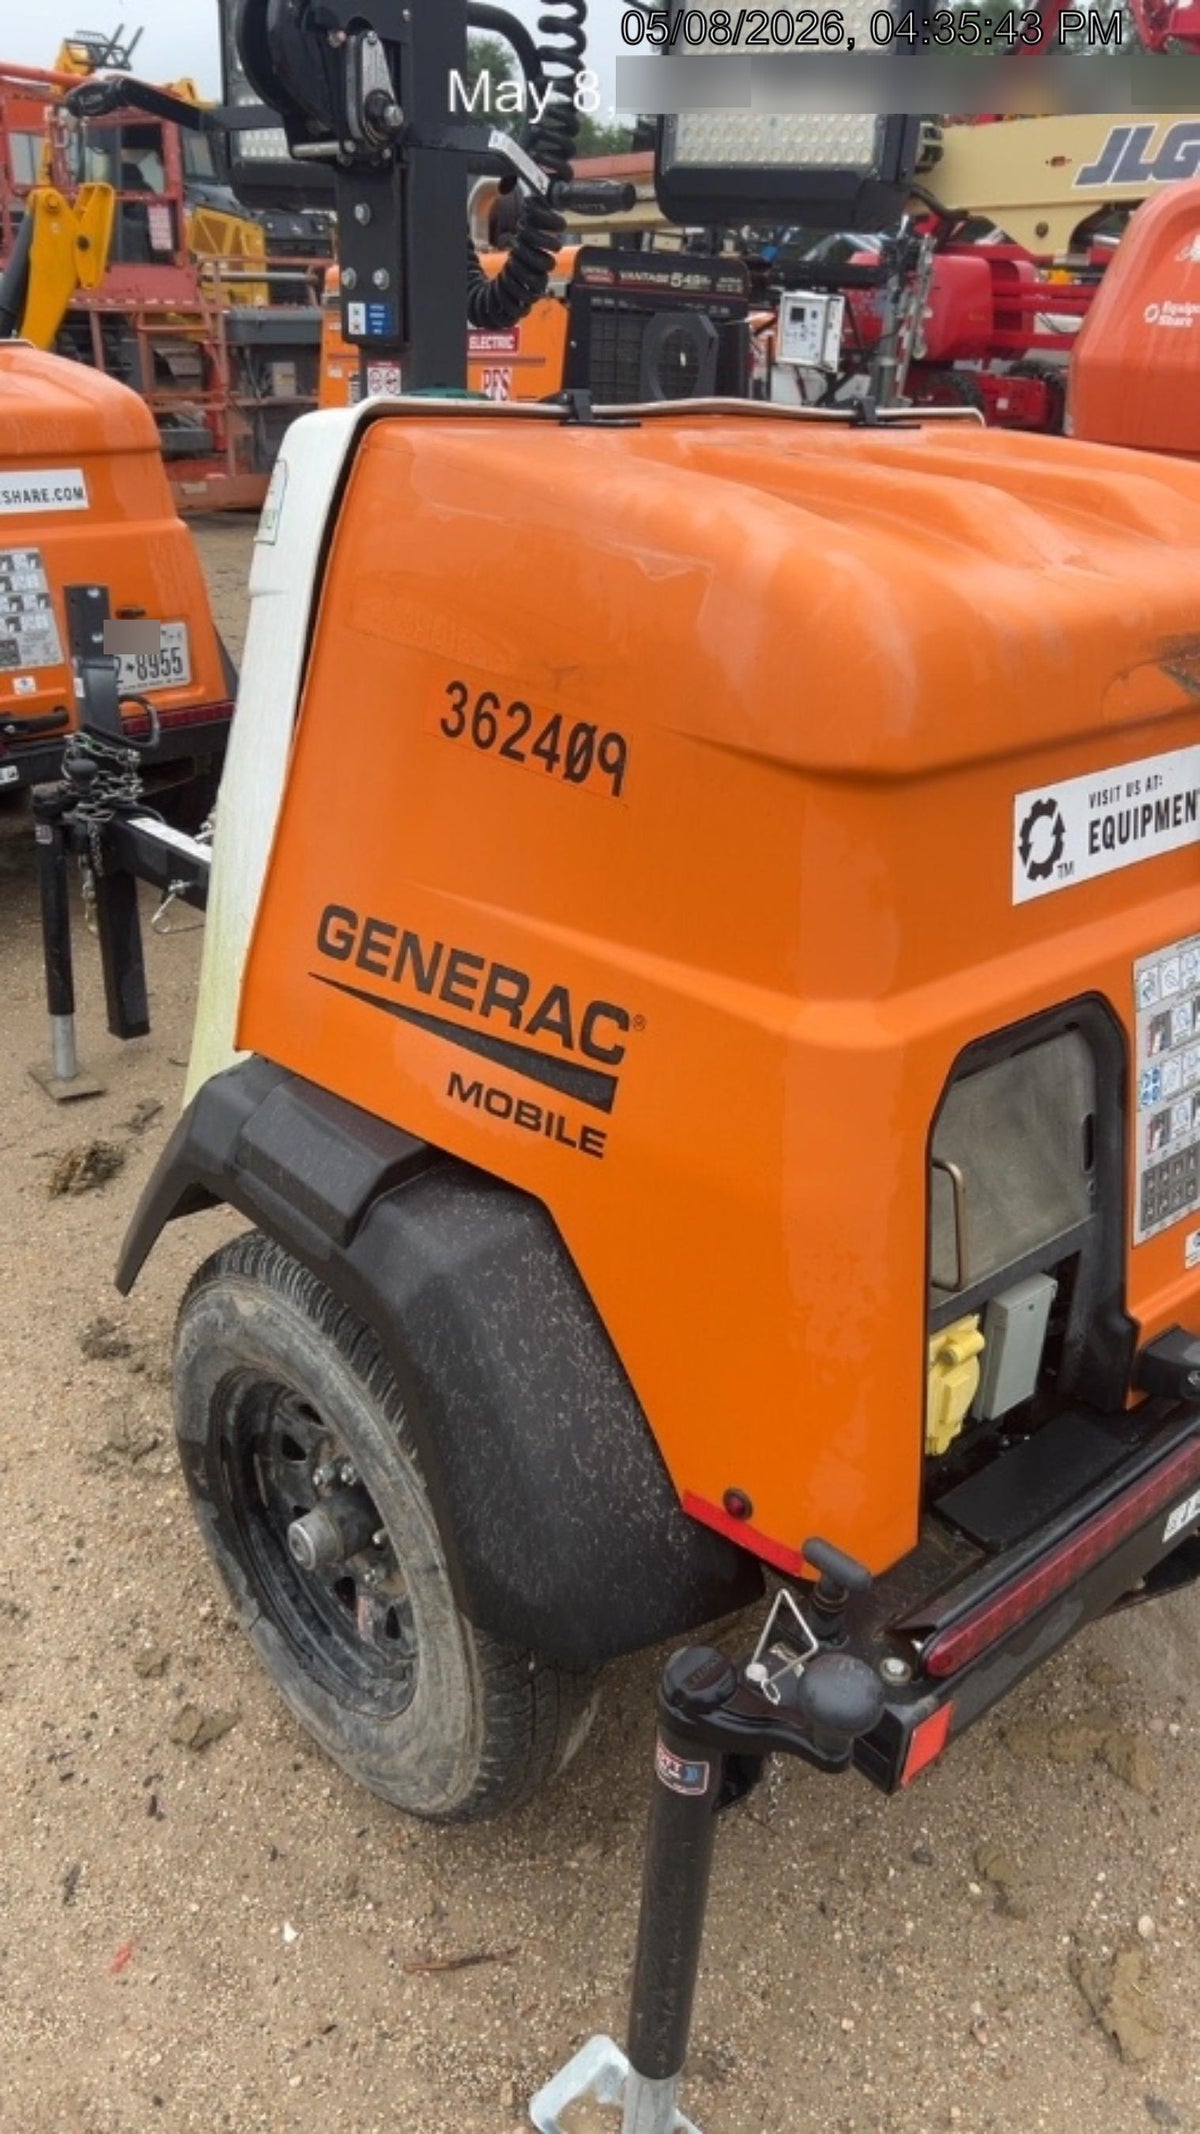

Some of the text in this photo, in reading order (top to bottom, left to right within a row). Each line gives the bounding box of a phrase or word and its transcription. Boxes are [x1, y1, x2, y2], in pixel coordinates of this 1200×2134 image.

[1073, 120, 1200, 186] JLG
[468, 334, 516, 350] ELECTRIC
[0, 487, 84, 505] SHARE.COM
[440, 679, 628, 798] 362409
[1088, 774, 1164, 809] VISIT US AT:
[1057, 860, 1075, 880] TM
[446, 1071, 608, 1160] MOBILE
